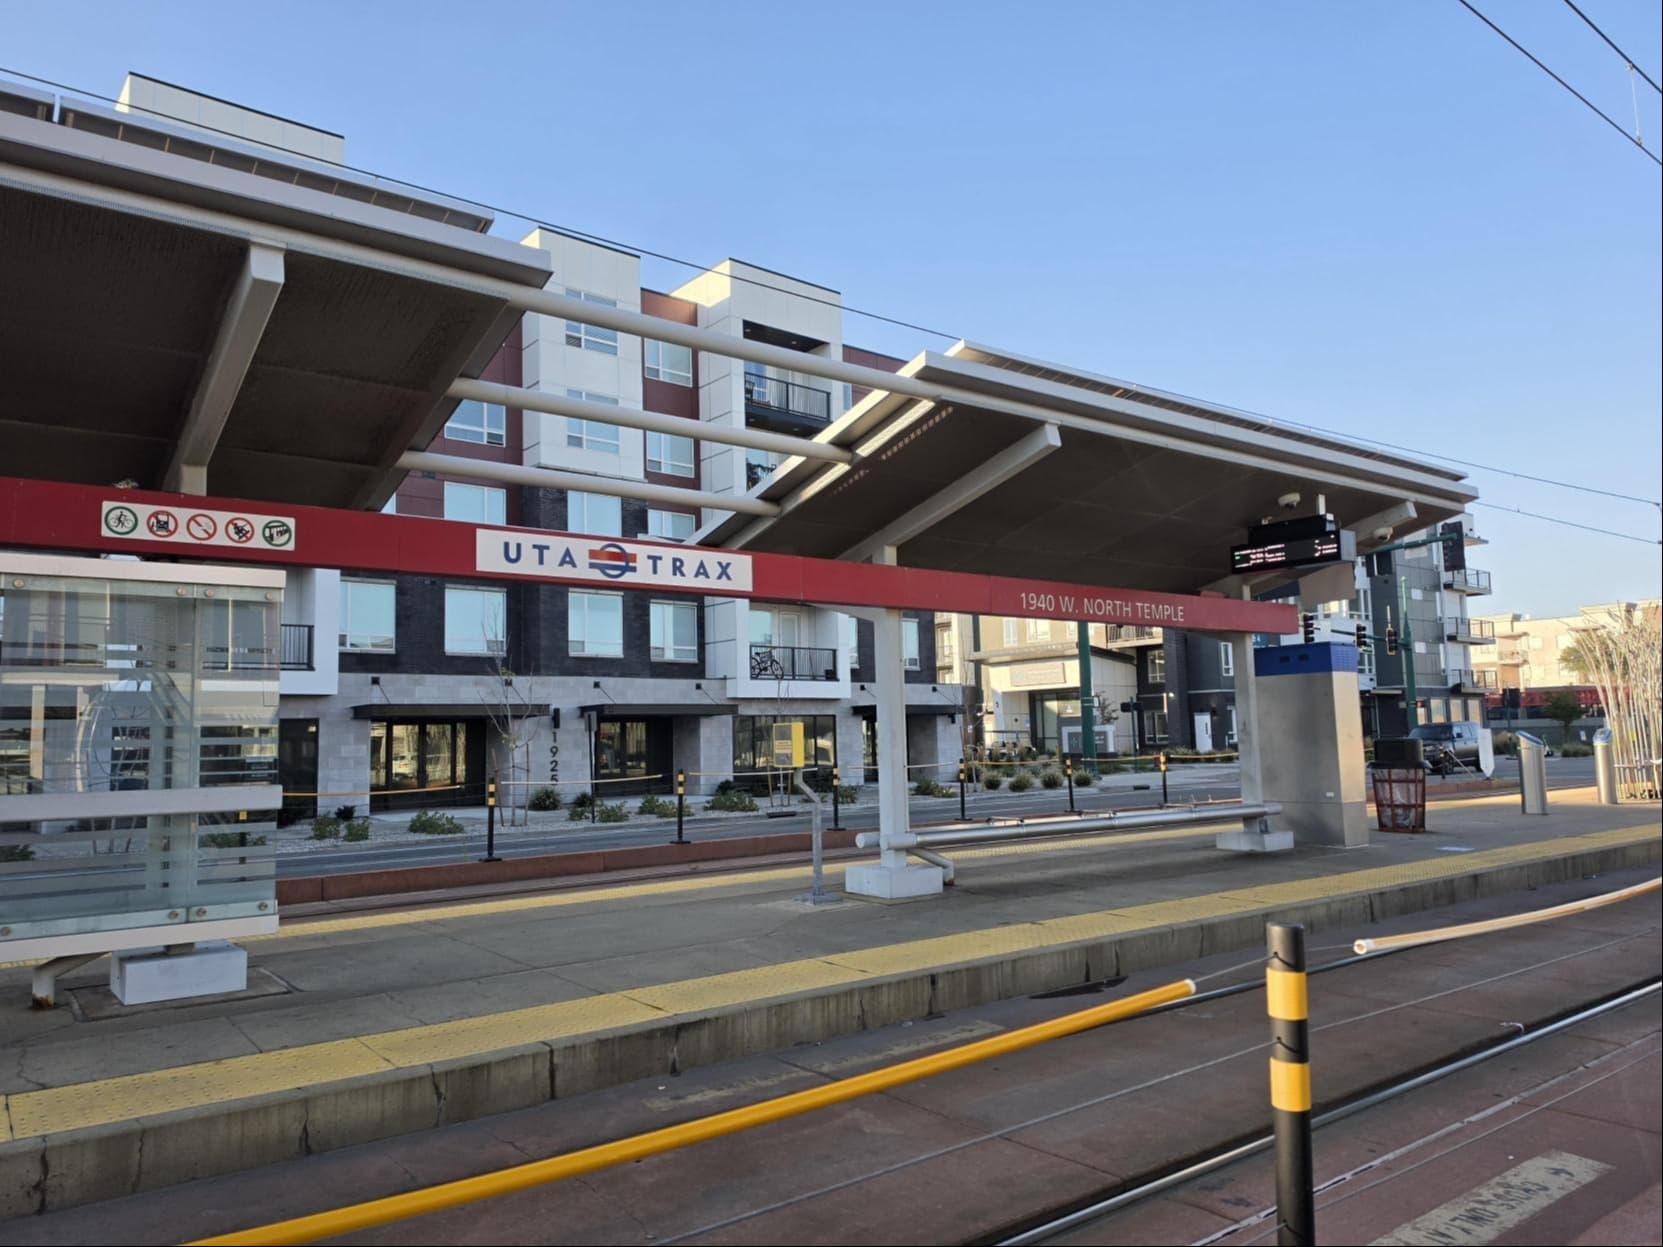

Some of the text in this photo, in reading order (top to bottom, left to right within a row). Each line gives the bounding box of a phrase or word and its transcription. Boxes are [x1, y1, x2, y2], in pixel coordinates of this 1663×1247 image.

[503, 541, 733, 581] UTA TRAX
[1020, 592, 1184, 622] 1940 W. NORTH TEMPLE
[550, 731, 560, 787] 1925
